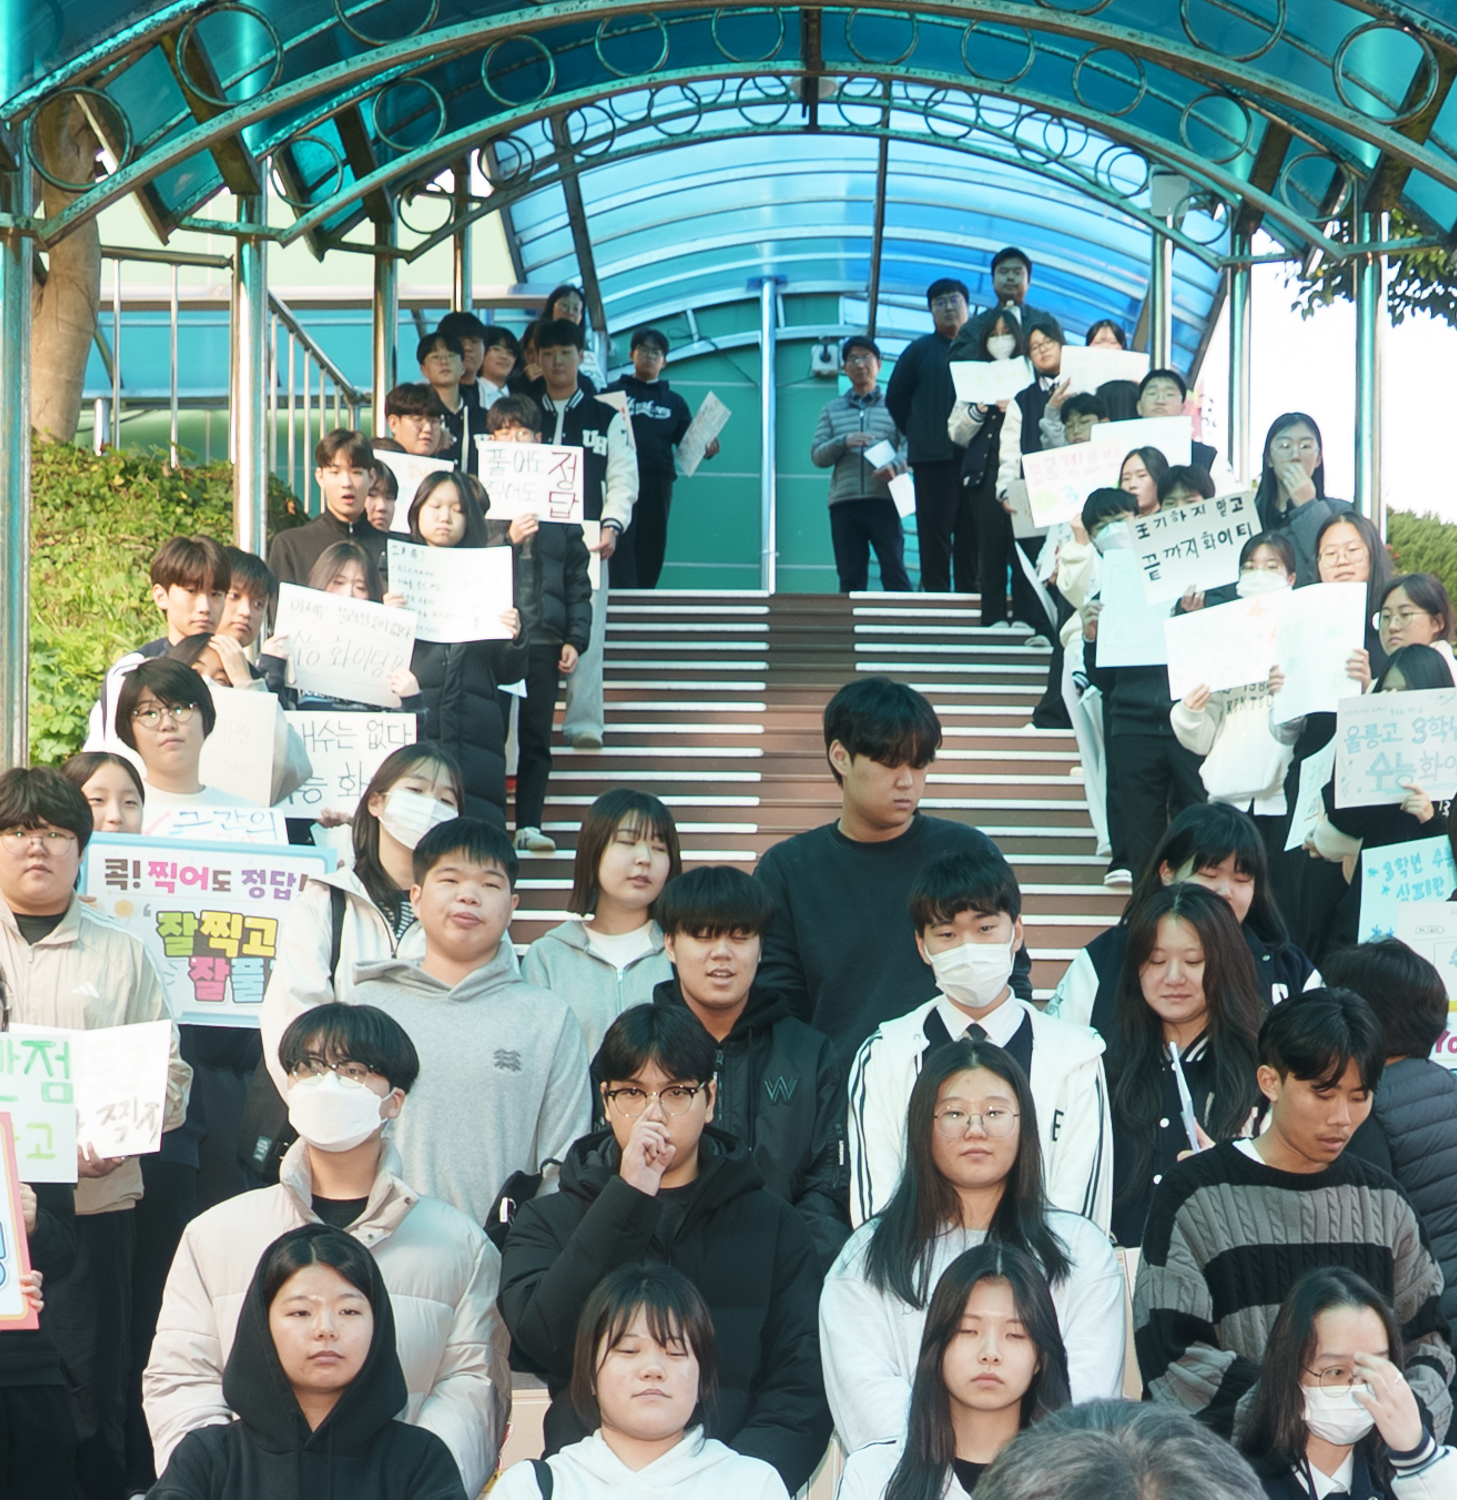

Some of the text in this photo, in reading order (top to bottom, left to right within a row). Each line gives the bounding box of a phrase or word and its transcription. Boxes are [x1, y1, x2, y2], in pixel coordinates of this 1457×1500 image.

[548, 450, 580, 519] 정답
[1135, 497, 1244, 540] 포기하지 말고
[367, 720, 413, 750] 없다
[1344, 722, 1403, 755] 울릉고
[1365, 751, 1417, 794] 수능
[173, 808, 278, 841] 그간의
[104, 858, 310, 901] 콕! 찍어도 정답!
